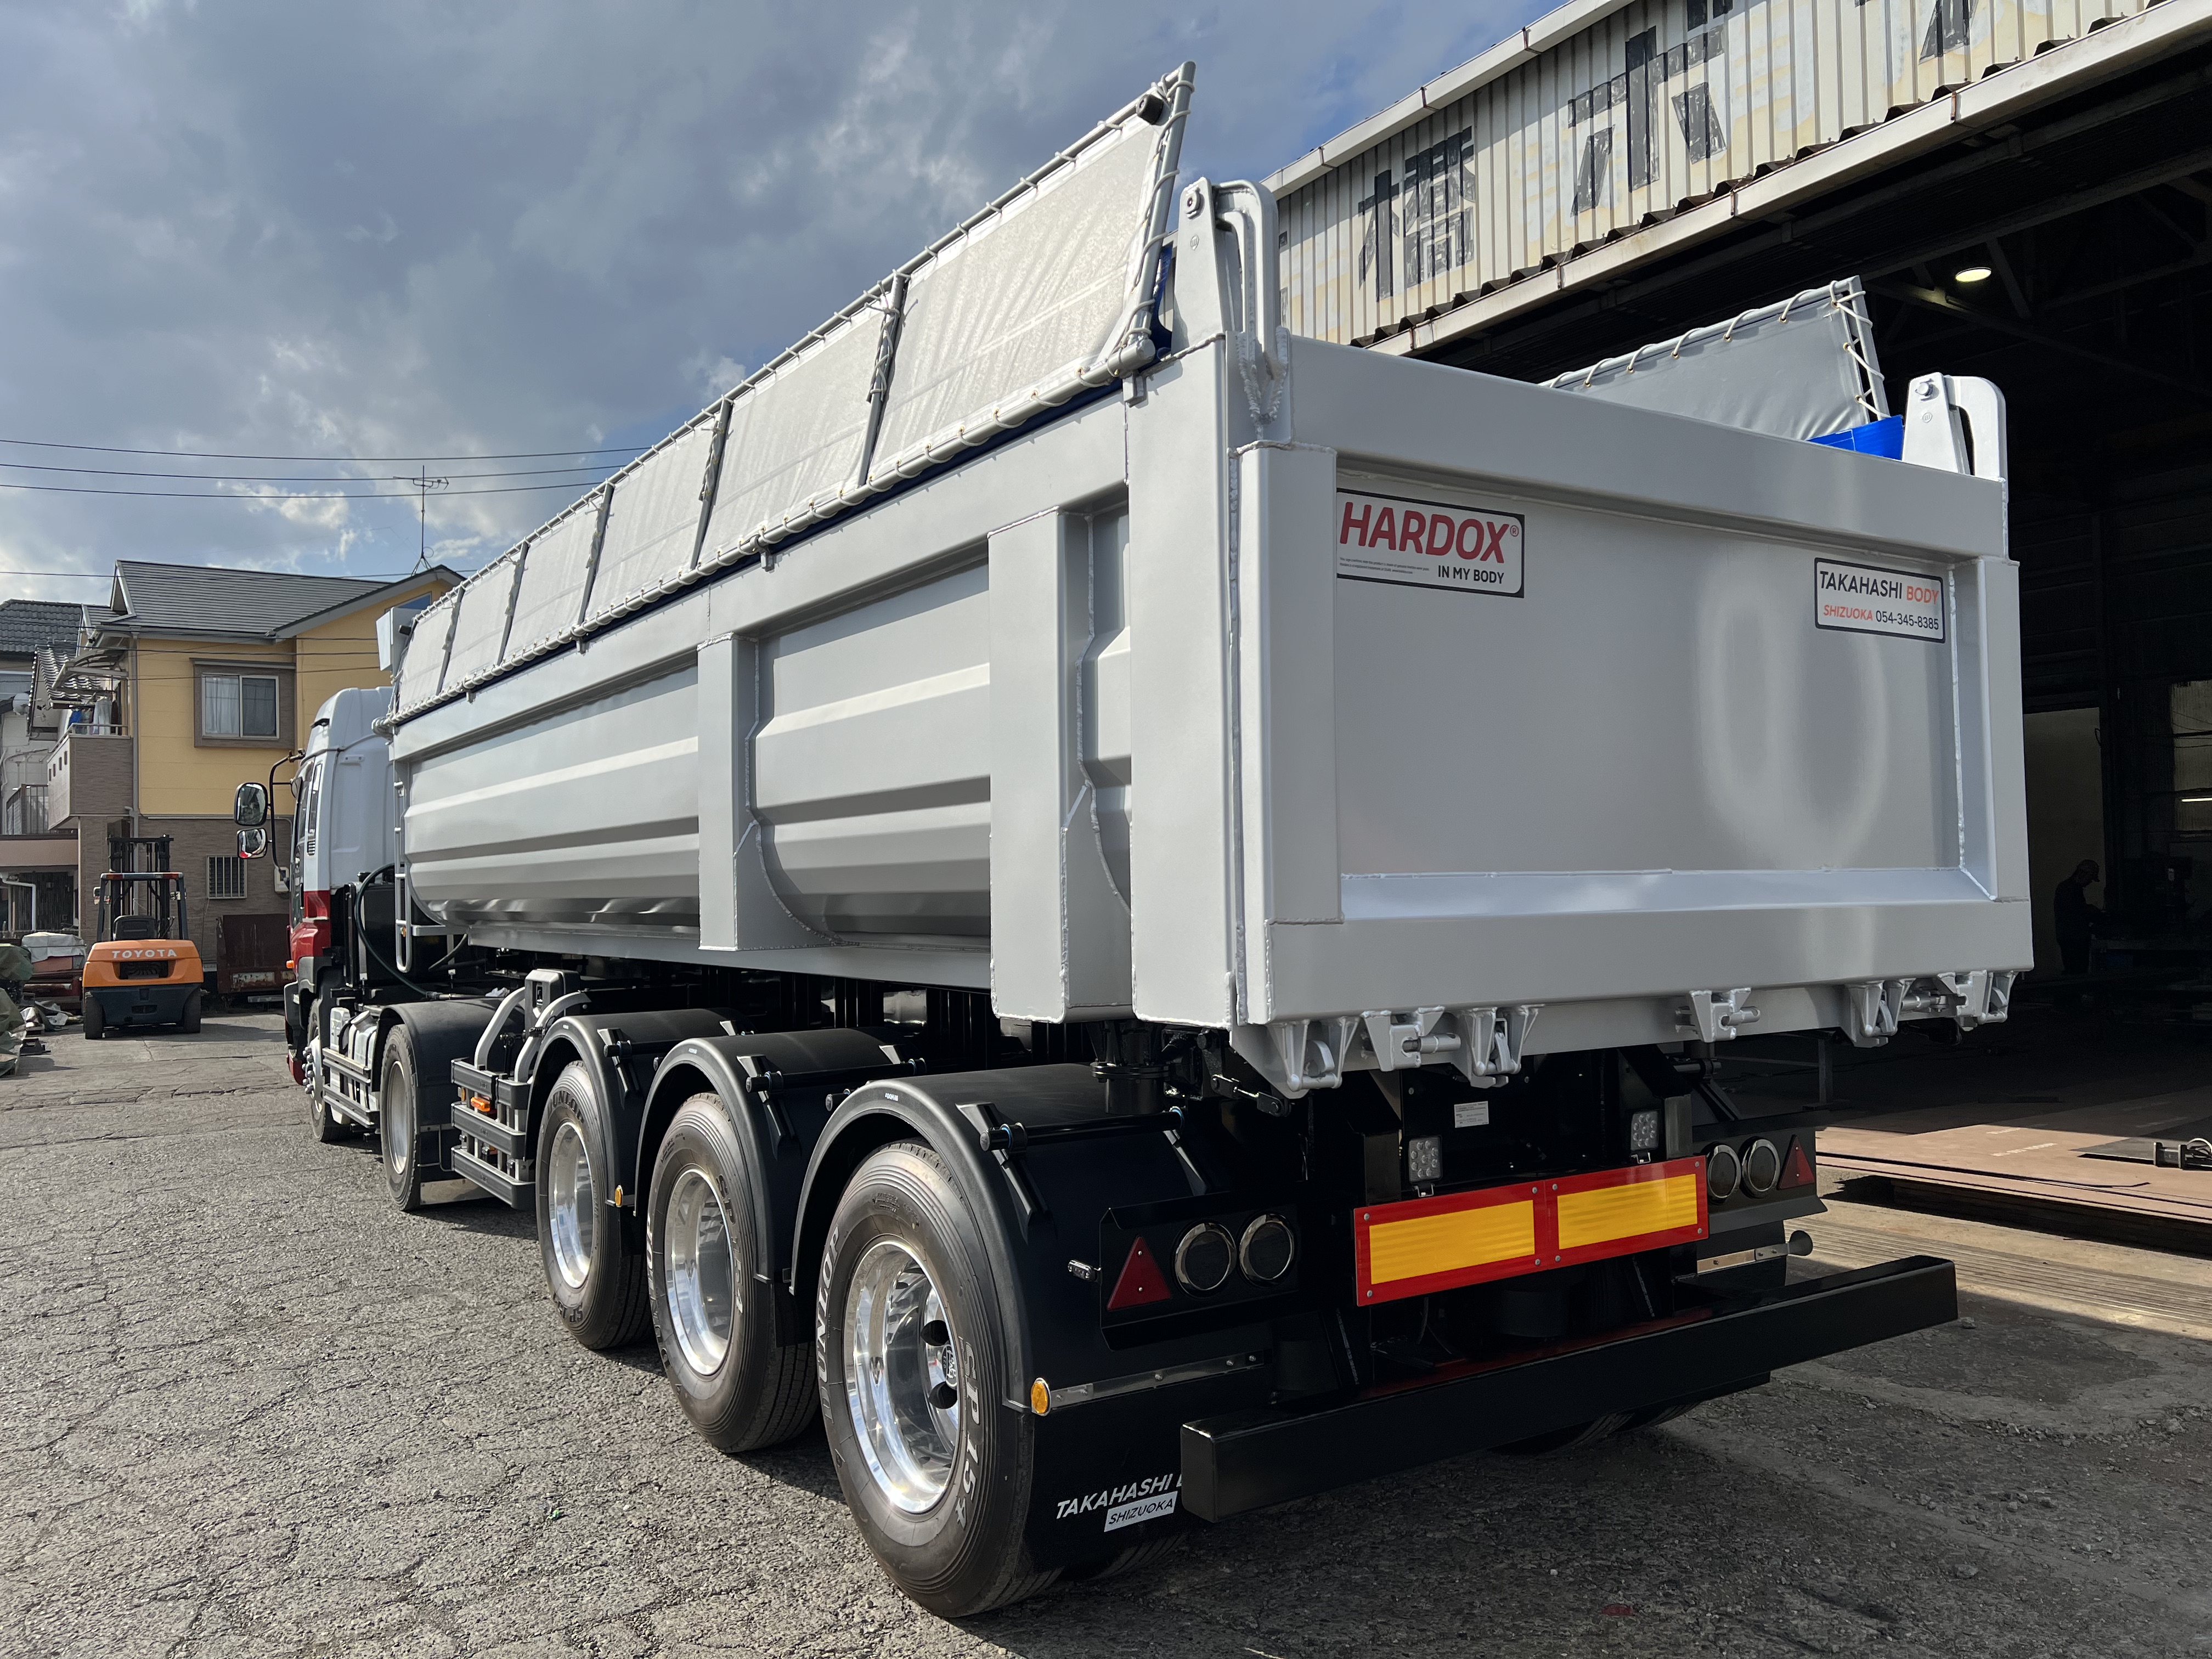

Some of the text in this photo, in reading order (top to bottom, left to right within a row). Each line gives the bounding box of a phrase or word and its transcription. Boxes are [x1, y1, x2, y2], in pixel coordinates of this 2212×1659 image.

[1438, 565, 1504, 584] IN MY BODY
[1820, 571, 1939, 605] TAKAHASHI BODY
[1823, 605, 1939, 630] SHIZUOKA 054-345-8385
[112, 949, 177, 959] TOYOTA
[716, 1174, 736, 1224] SP
[816, 1225, 839, 1425] DUNLOP
[955, 1336, 980, 1531] SP 154
[1056, 1474, 1173, 1519] TAKAHASHI
[1108, 1498, 1173, 1525] SHIZUOKA
